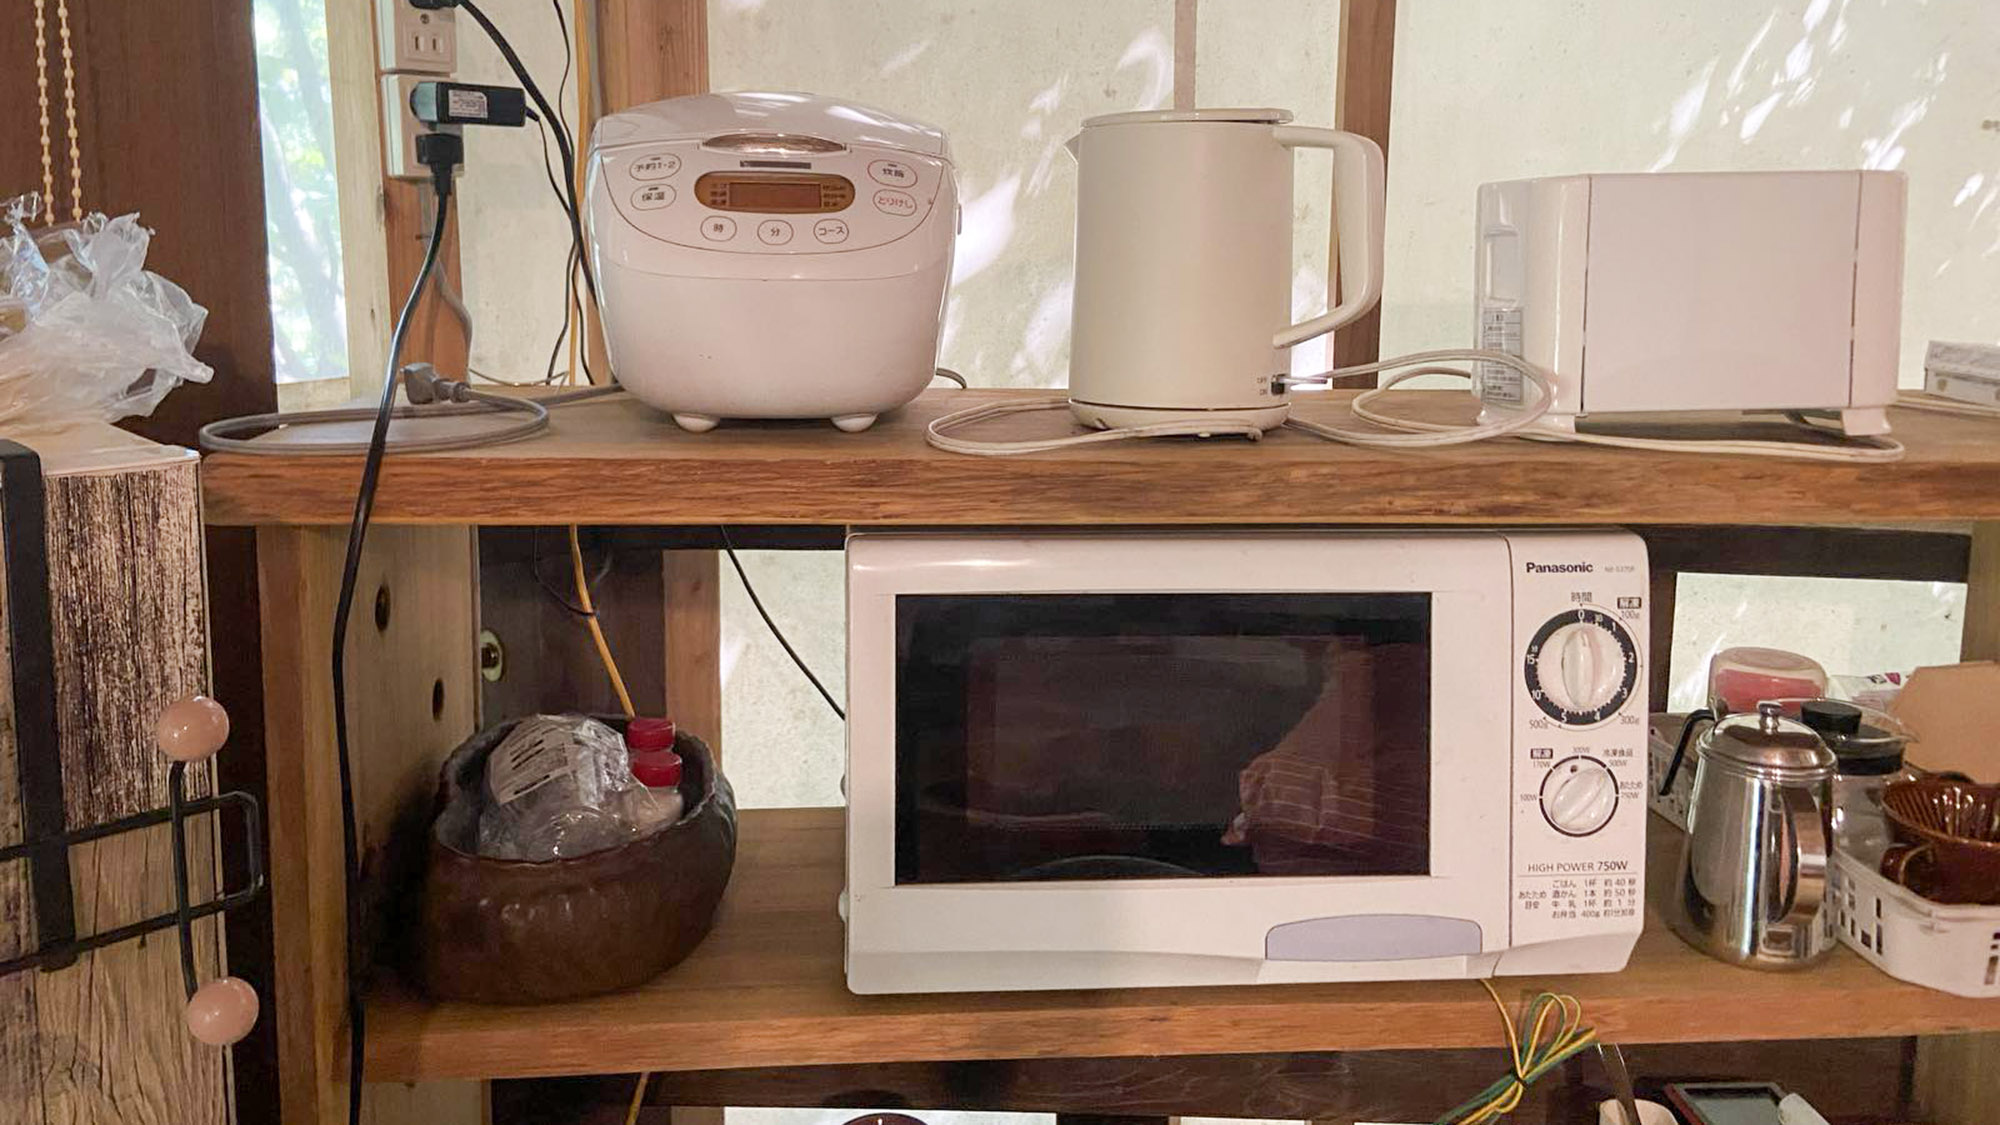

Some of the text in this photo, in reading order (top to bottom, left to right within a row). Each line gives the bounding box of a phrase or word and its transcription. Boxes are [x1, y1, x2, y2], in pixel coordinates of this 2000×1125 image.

[878, 197, 912, 209] とりけし
[818, 226, 845, 236] コース
[1526, 562, 1594, 573] Panasonic
[1571, 592, 1592, 602] 時間
[1578, 609, 1585, 620] 0
[1527, 654, 1535, 665] 15
[1628, 653, 1635, 663] 2
[1532, 689, 1541, 700] 10
[1621, 688, 1628, 699] 3
[1561, 713, 1567, 723] 5
[1594, 713, 1600, 722] 4
[1528, 860, 1628, 873] HIGH POWER 750W
[1552, 880, 1577, 889] ごはん
[1519, 890, 1547, 899] あたため
